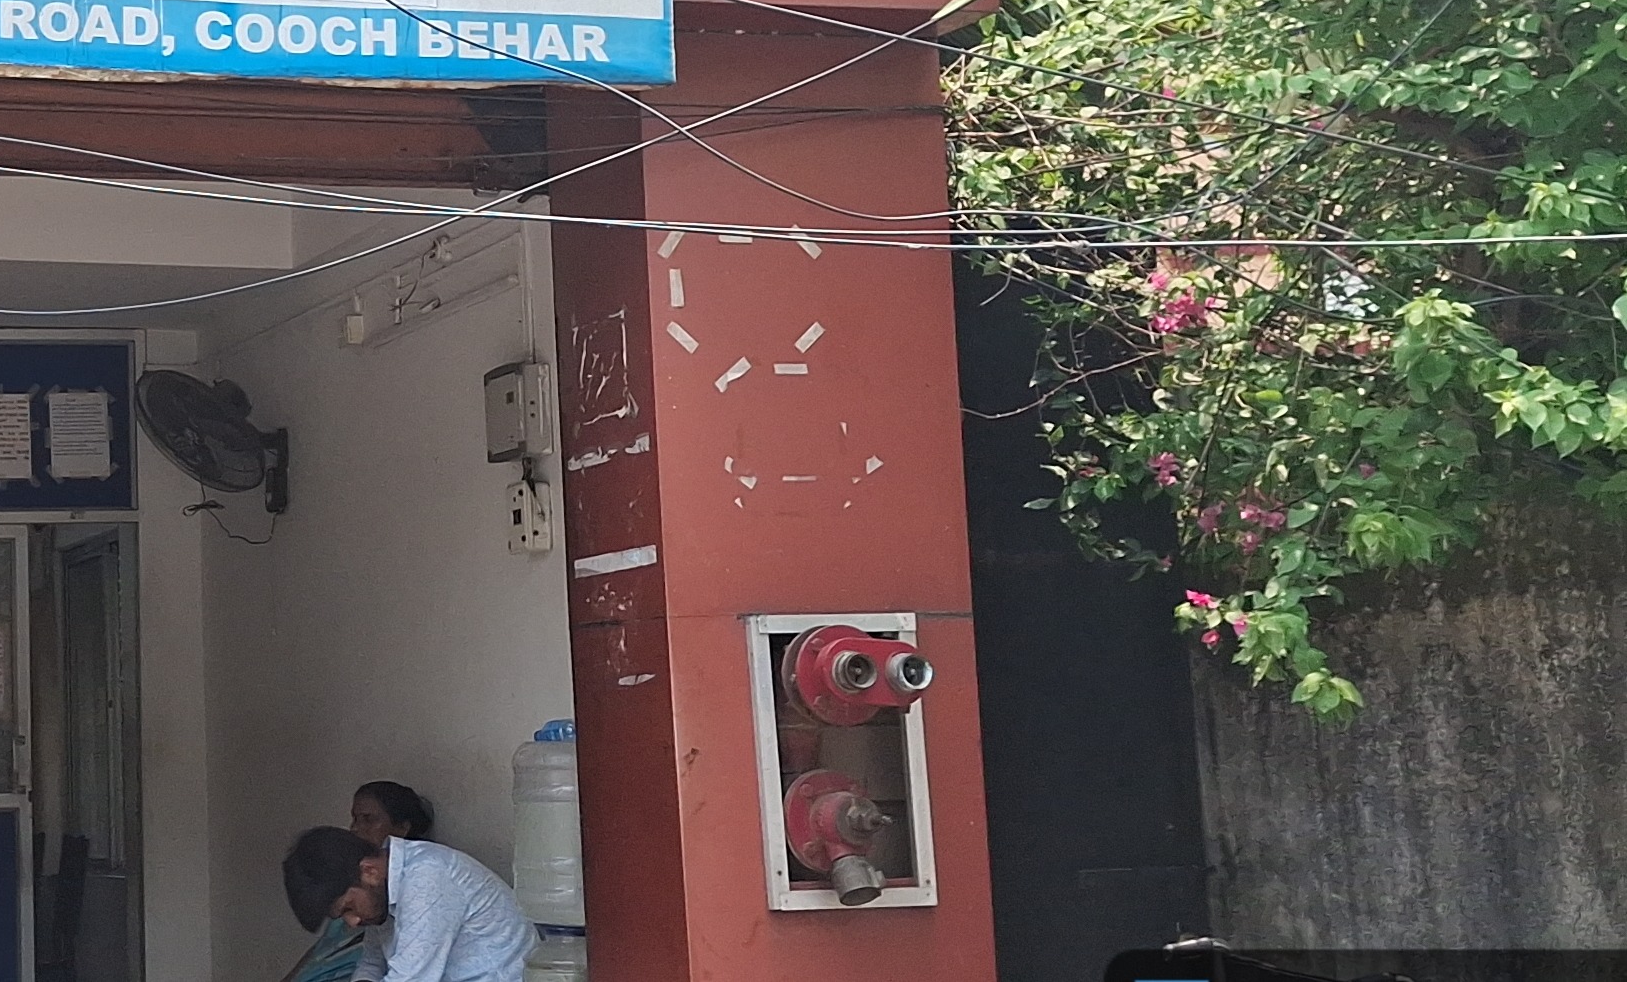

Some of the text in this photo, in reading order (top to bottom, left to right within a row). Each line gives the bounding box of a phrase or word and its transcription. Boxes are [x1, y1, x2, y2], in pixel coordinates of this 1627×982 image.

[0, 0, 176, 57] ROAD,
[196, 10, 399, 57] COOCH
[418, 18, 610, 63] BEHAR
